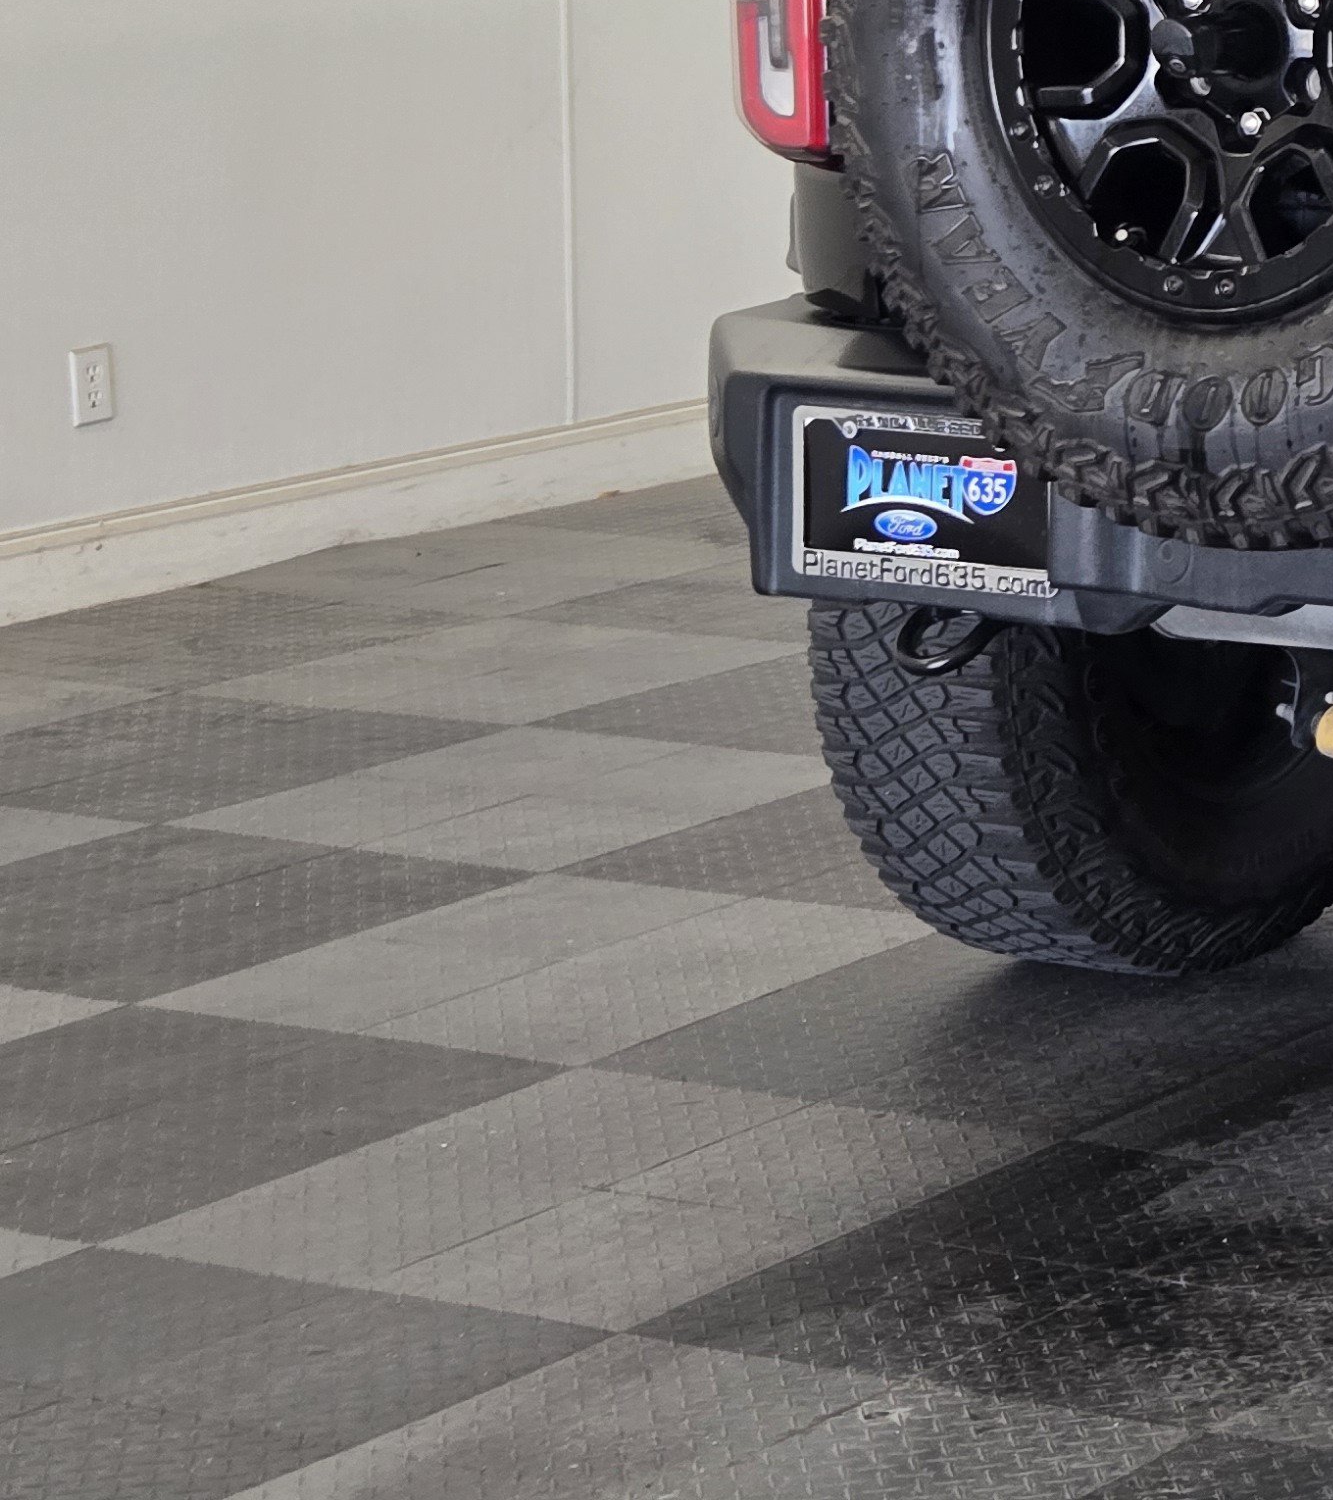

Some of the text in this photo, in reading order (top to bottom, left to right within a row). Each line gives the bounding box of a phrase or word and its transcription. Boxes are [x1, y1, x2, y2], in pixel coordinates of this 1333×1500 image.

[847, 444, 968, 516] PLANET
[967, 476, 1007, 505] 635
[802, 550, 1053, 598] PlanetFord635.com
